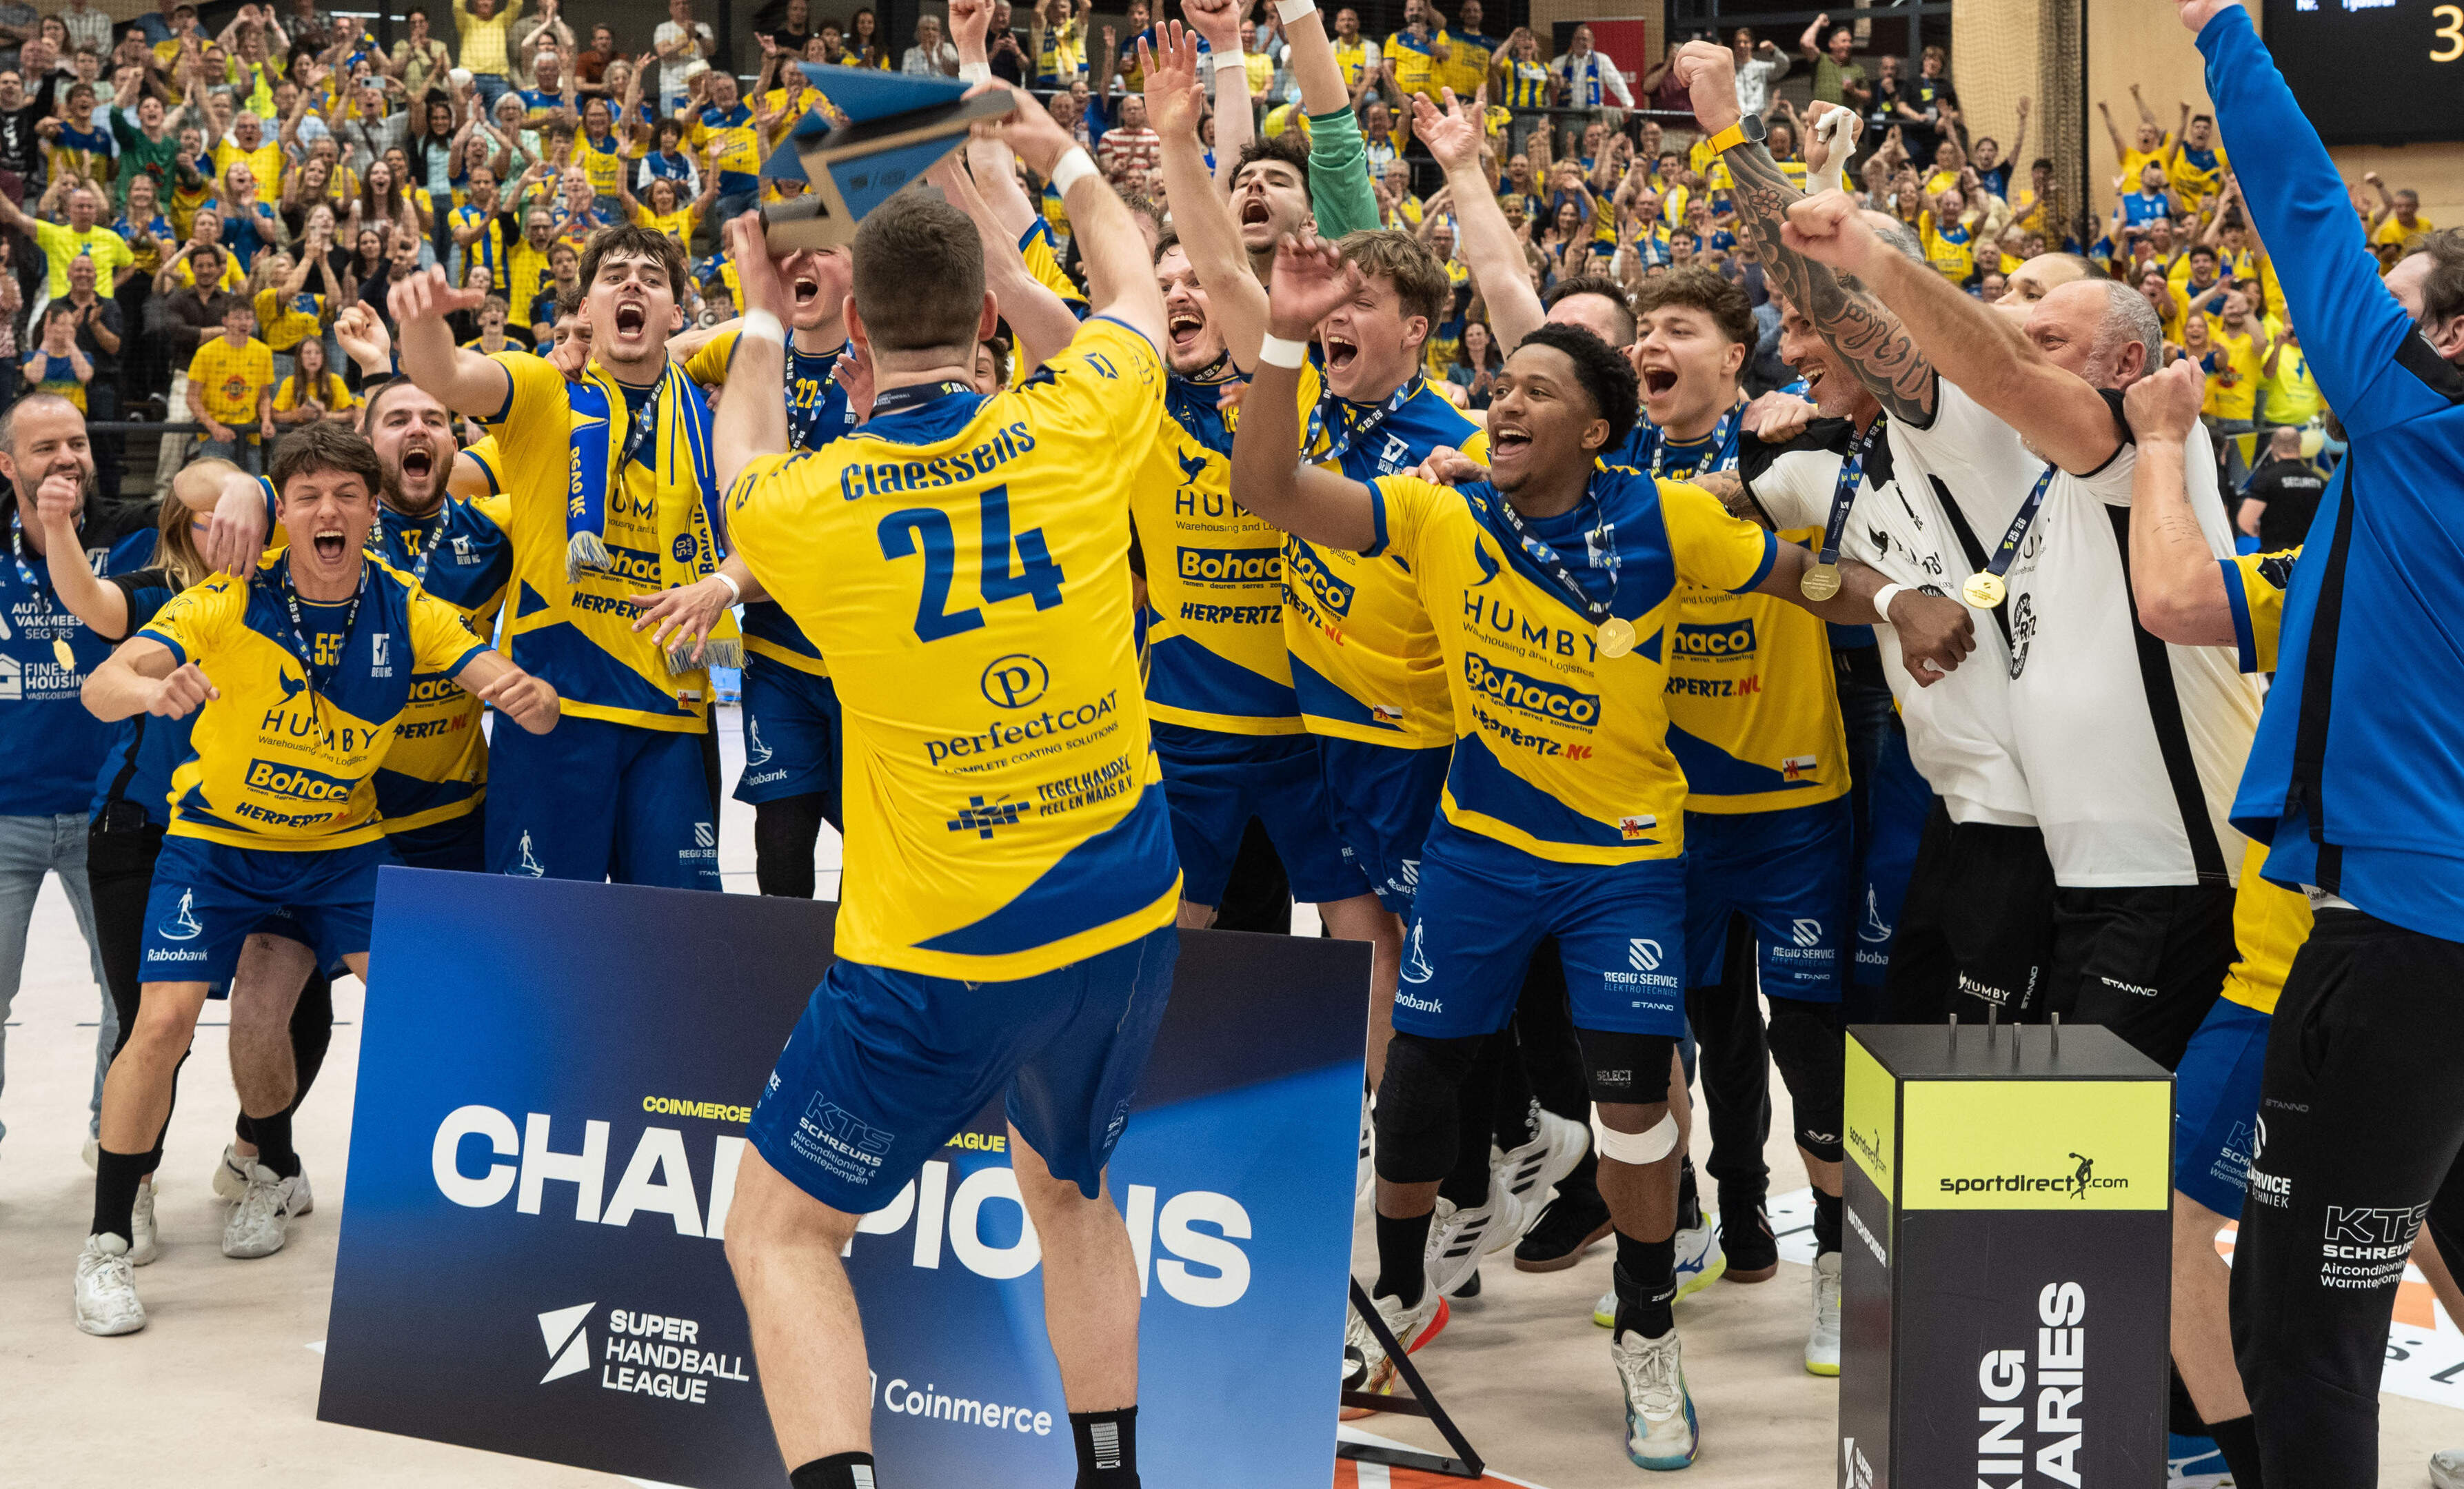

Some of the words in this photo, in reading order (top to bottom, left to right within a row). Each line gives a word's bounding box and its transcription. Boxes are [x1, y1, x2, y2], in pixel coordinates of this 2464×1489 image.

[2430, 5, 2464, 62] 3
[796, 378, 818, 409] 22
[845, 414, 856, 423] BEV
[1362, 409, 1384, 429] 25/26
[1175, 520, 1239, 534] Warehousing
[1242, 522, 1260, 531] and
[2008, 517, 2027, 543] 25/26
[401, 529, 422, 556] 17
[676, 540, 687, 557] 50
[877, 483, 1066, 644] 24
[1181, 551, 1282, 579] Bohac
[1328, 547, 1356, 566] gistics
[15, 616, 84, 627] VAKMEES
[288, 602, 301, 623] 25/26
[1180, 602, 1282, 625] HERPERTZ
[26, 628, 74, 639] SEGRS
[1464, 589, 1597, 662] HUMBY
[314, 632, 342, 666] 55
[1550, 660, 1595, 678] Logistics
[26, 674, 85, 689] HOUSIN
[1466, 654, 1595, 722] Bohaco
[1663, 674, 1761, 698] RPERTZ.NL
[26, 690, 81, 700] VASTGOEDBEH
[393, 712, 468, 740] PERTZ.NL
[1550, 718, 1593, 734] zonwering
[259, 735, 316, 756] Warehousing
[1012, 742, 1063, 764] COATING
[1066, 721, 1119, 749] SOLUTIONS
[248, 762, 350, 801] Bohac
[749, 768, 788, 786] bobank
[1036, 753, 1133, 801] TEGELHANDEL
[1039, 799, 1065, 816] PEEL
[1069, 796, 1083, 810] EN
[1087, 784, 1117, 805] MAAS
[1118, 775, 1136, 792] B.V.
[147, 948, 208, 962] Rabobank
[1802, 949, 1835, 959] SERVICE
[1604, 971, 1638, 985] REGIO
[1639, 973, 1678, 989] SERVICE
[1604, 983, 1678, 998] ELEKTROTECHNIEK
[1965, 979, 2010, 1002] HUMBY
[2101, 976, 2159, 997] STANNO
[1394, 989, 1443, 1013] bobank
[1631, 1001, 1675, 1011] STANNO
[1597, 1069, 1633, 1082] SELECT
[643, 1095, 753, 1124] COINMERCE
[945, 1131, 1007, 1153] AGUE
[805, 1090, 895, 1155] KTS
[799, 1116, 883, 1168] SCHREURS
[790, 1137, 869, 1186] Warmtepompen
[794, 1130, 867, 1177] Airconditioning
[868, 1169, 876, 1178] &
[2323, 1239, 2415, 1260] SCHREUR
[2321, 1258, 2407, 1276] Airconditionin
[609, 1309, 699, 1344] SUPER
[605, 1337, 750, 1382] HANDBALL
[602, 1366, 709, 1405] LEAGUE
[884, 1377, 1053, 1437] Coinmerce
